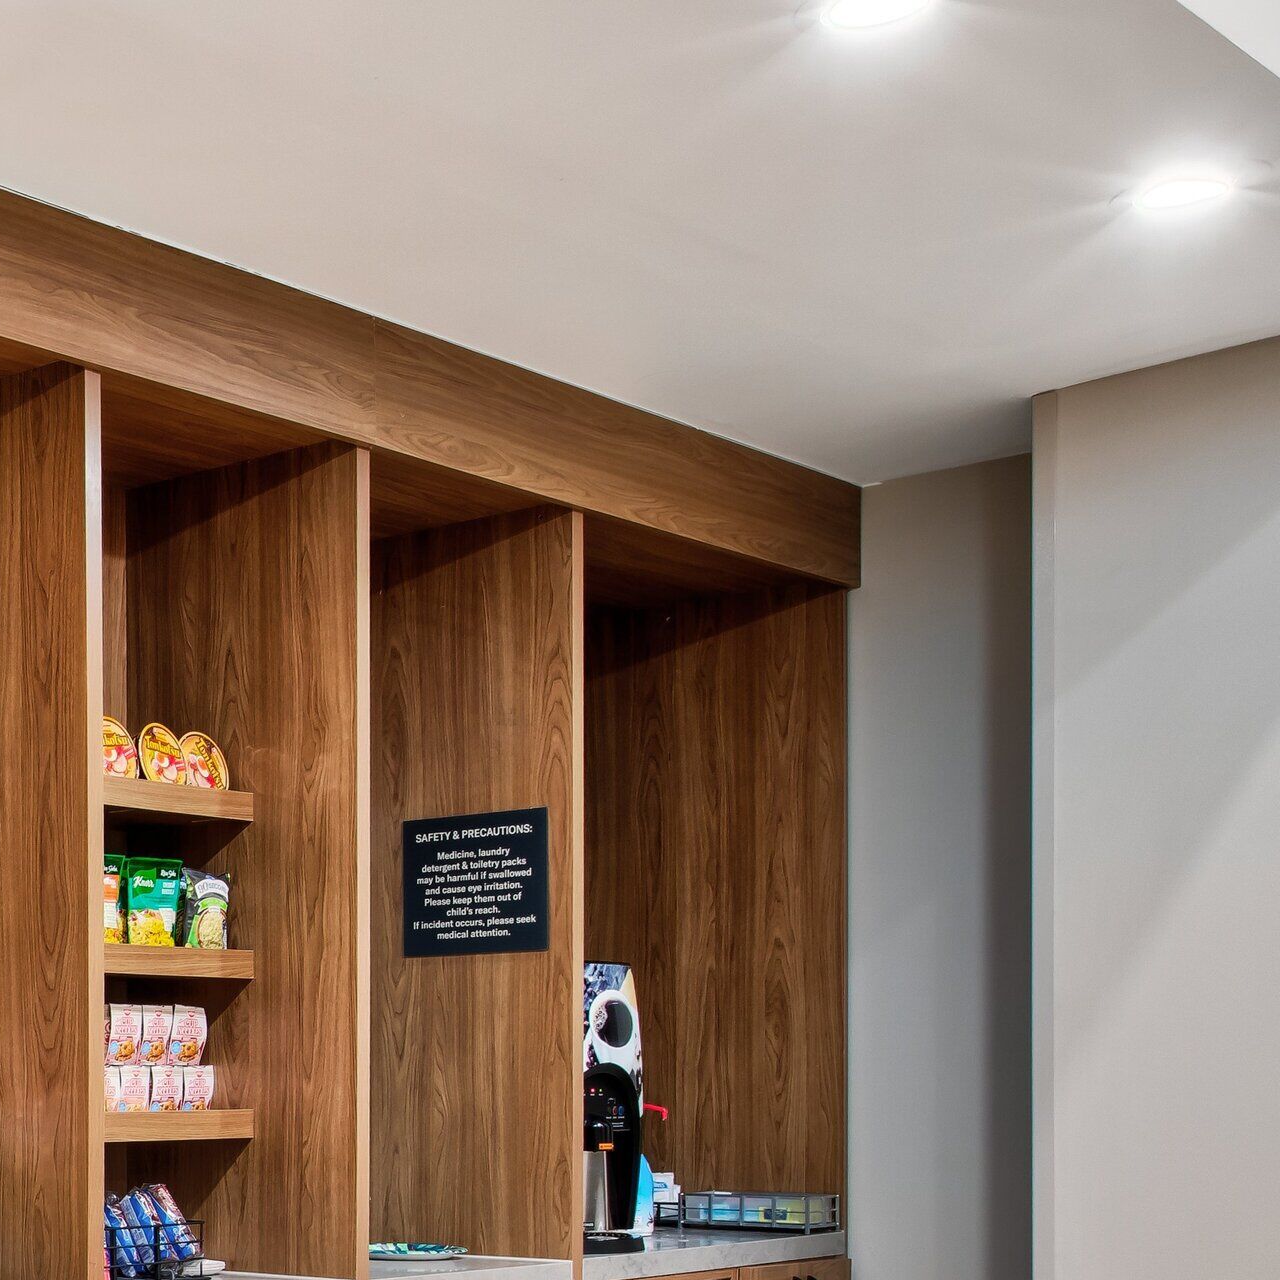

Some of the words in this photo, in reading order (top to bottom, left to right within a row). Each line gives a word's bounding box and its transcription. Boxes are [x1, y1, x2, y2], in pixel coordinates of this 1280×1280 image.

[144, 735, 180, 758] Tonkotsu
[195, 738, 224, 790] Tonkotsu
[415, 831, 451, 843] SAFETY
[452, 830, 460, 840] &
[461, 824, 533, 839] PRECAUTIONS:
[437, 850, 477, 861] Medicine,
[478, 847, 510, 857] laundry
[422, 863, 460, 873] detergent
[461, 862, 468, 870] &
[470, 860, 500, 870] toiletry
[501, 857, 527, 868] packs
[417, 876, 433, 886] may
[435, 875, 445, 883] be
[447, 872, 479, 882] harmful
[480, 871, 487, 880] if
[488, 868, 532, 879] swallowed
[425, 887, 440, 896] and
[442, 886, 466, 894] cause
[467, 884, 482, 894] eye
[484, 881, 523, 891] irritation.
[424, 897, 451, 907] Please
[452, 896, 472, 906] keep
[474, 894, 495, 903] them
[497, 893, 511, 901] out
[513, 892, 522, 900] of
[446, 907, 473, 917] child's
[475, 906, 501, 915] reach.
[413, 921, 419, 930] If
[421, 920, 454, 929] incident
[455, 918, 485, 927] occurs,
[487, 916, 514, 927] please
[516, 914, 537, 923] seek
[437, 930, 469, 940] medical
[470, 928, 511, 938] attention.
